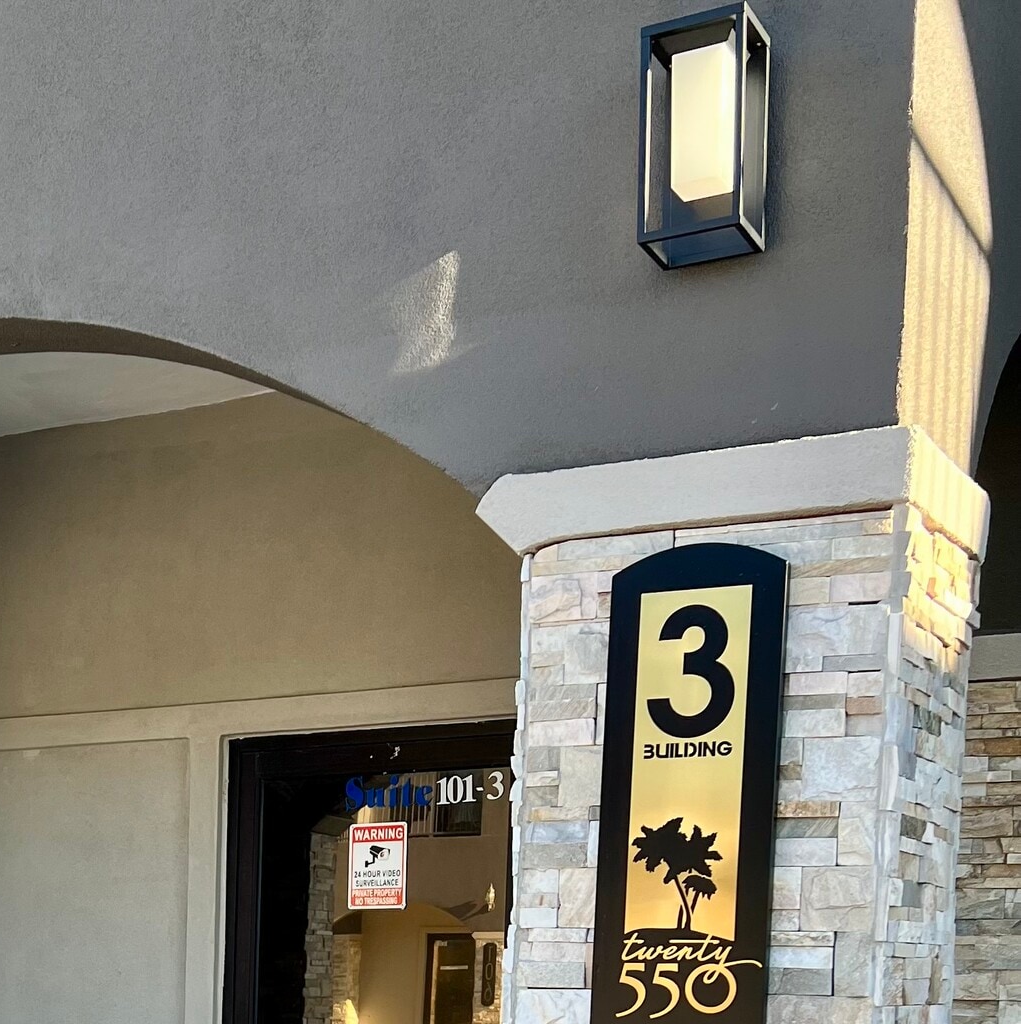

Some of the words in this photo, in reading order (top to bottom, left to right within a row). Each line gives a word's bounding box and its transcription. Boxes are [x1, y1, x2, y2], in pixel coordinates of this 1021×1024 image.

[646, 604, 736, 739] 3
[643, 741, 733, 759] BUILDING
[345, 775, 433, 812] Suite
[436, 771, 504, 806] 101-3
[354, 828, 403, 841] WARNING
[363, 870, 381, 878] HOUR
[382, 869, 401, 877] VIDEO
[356, 878, 399, 887] SURVEILLANCE
[352, 889, 374, 898] PRIVATE
[374, 888, 402, 897] PROPERTY
[355, 897, 363, 905] NO
[364, 896, 398, 905] TRESPASSING
[621, 932, 763, 984] twenty
[615, 962, 737, 1019] 550
